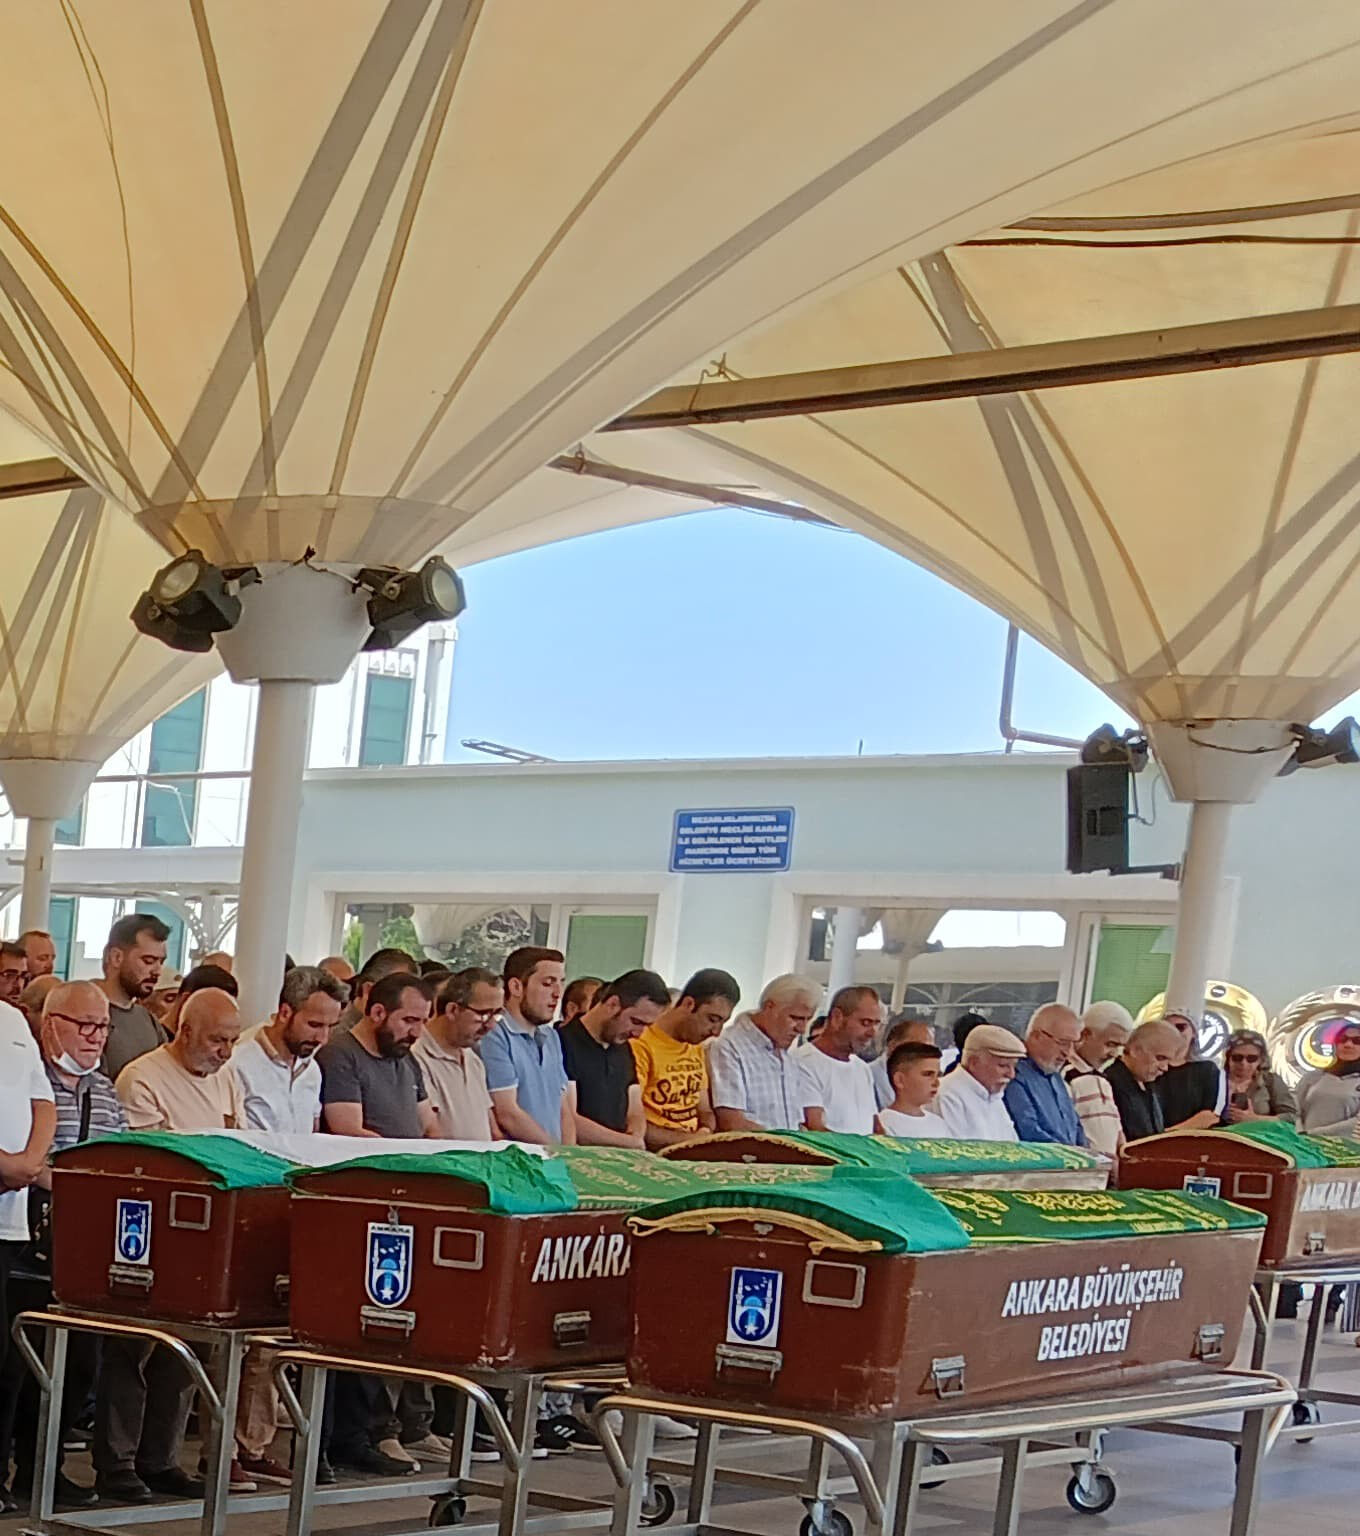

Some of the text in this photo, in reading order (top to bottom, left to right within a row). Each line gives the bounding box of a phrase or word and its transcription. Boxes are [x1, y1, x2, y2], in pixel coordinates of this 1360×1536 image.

[1001, 1259, 1184, 1318] ANKARA BÜYÜKŞEHİR
[1037, 1310, 1133, 1361] BELEDİYESİ
